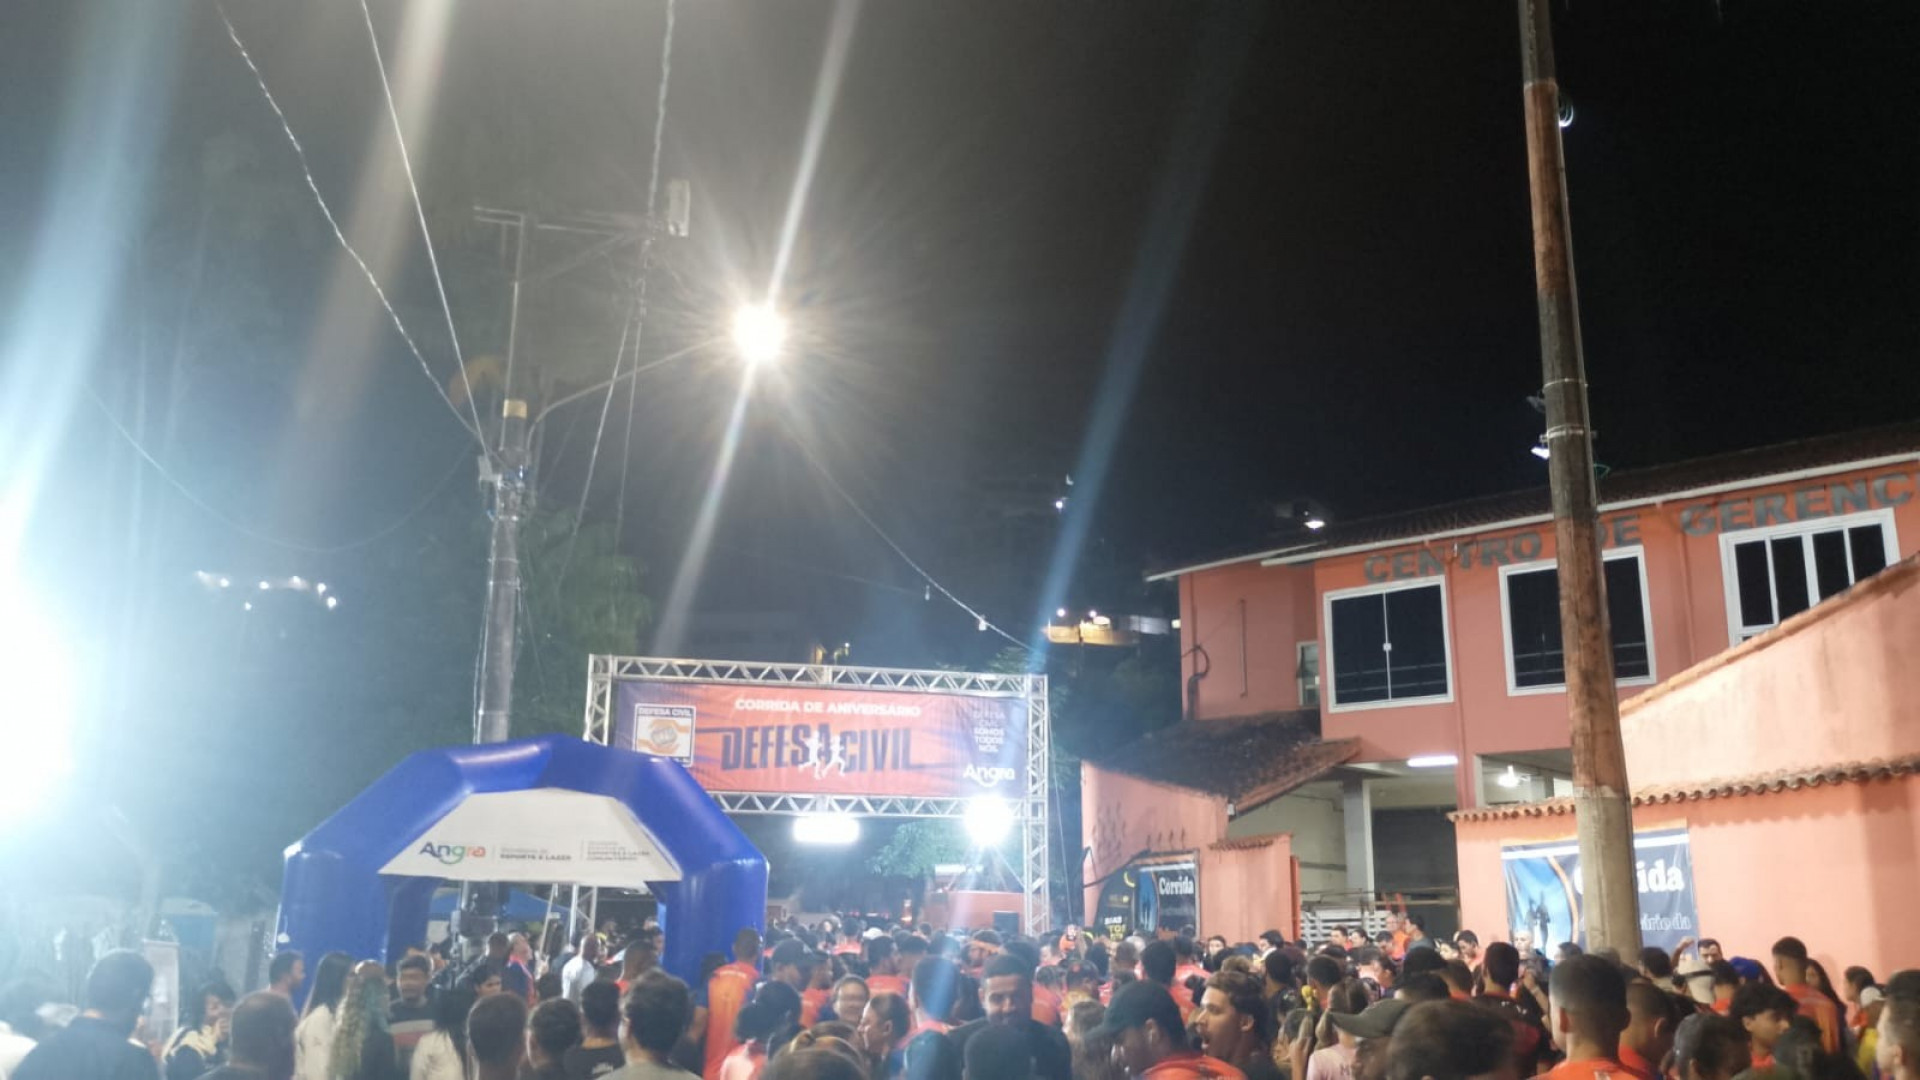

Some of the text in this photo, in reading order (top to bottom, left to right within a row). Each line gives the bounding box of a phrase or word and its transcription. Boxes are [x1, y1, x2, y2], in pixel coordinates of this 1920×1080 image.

[1364, 531, 1542, 584] CENTRO
[1680, 473, 1920, 537] GERENC
[734, 698, 800, 713] CORRIDA
[803, 701, 825, 714] DE
[839, 728, 914, 774] CIVIL
[963, 763, 1016, 788] Angra
[419, 841, 486, 865] Angra
